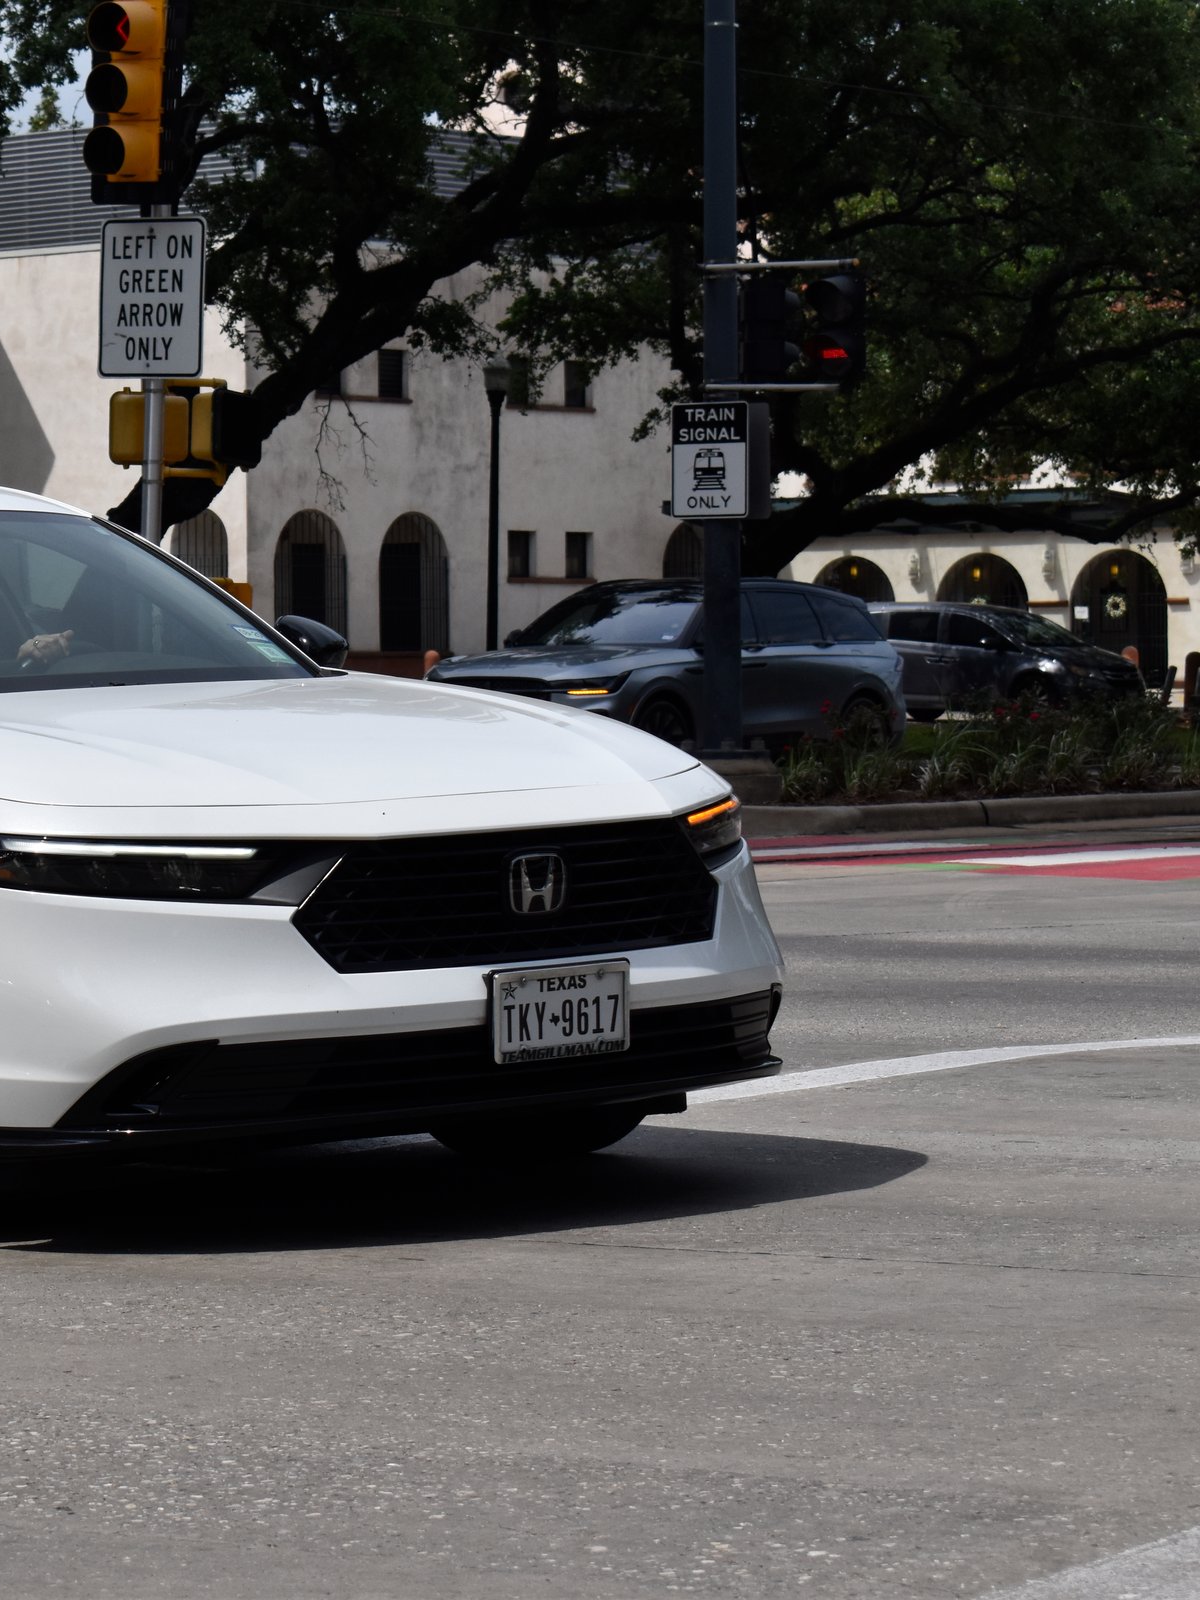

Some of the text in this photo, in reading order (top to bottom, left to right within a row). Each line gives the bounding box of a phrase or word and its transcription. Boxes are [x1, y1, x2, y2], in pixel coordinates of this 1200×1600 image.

[112, 234, 193, 260] LEFT ON
[119, 269, 184, 294] GREEN
[117, 302, 184, 327] ARROW
[125, 336, 173, 361] ONLY
[685, 407, 735, 422] TRAIN
[679, 427, 740, 442] SIGNAL
[687, 495, 731, 509] ONLY
[537, 974, 587, 993] TEXAS
